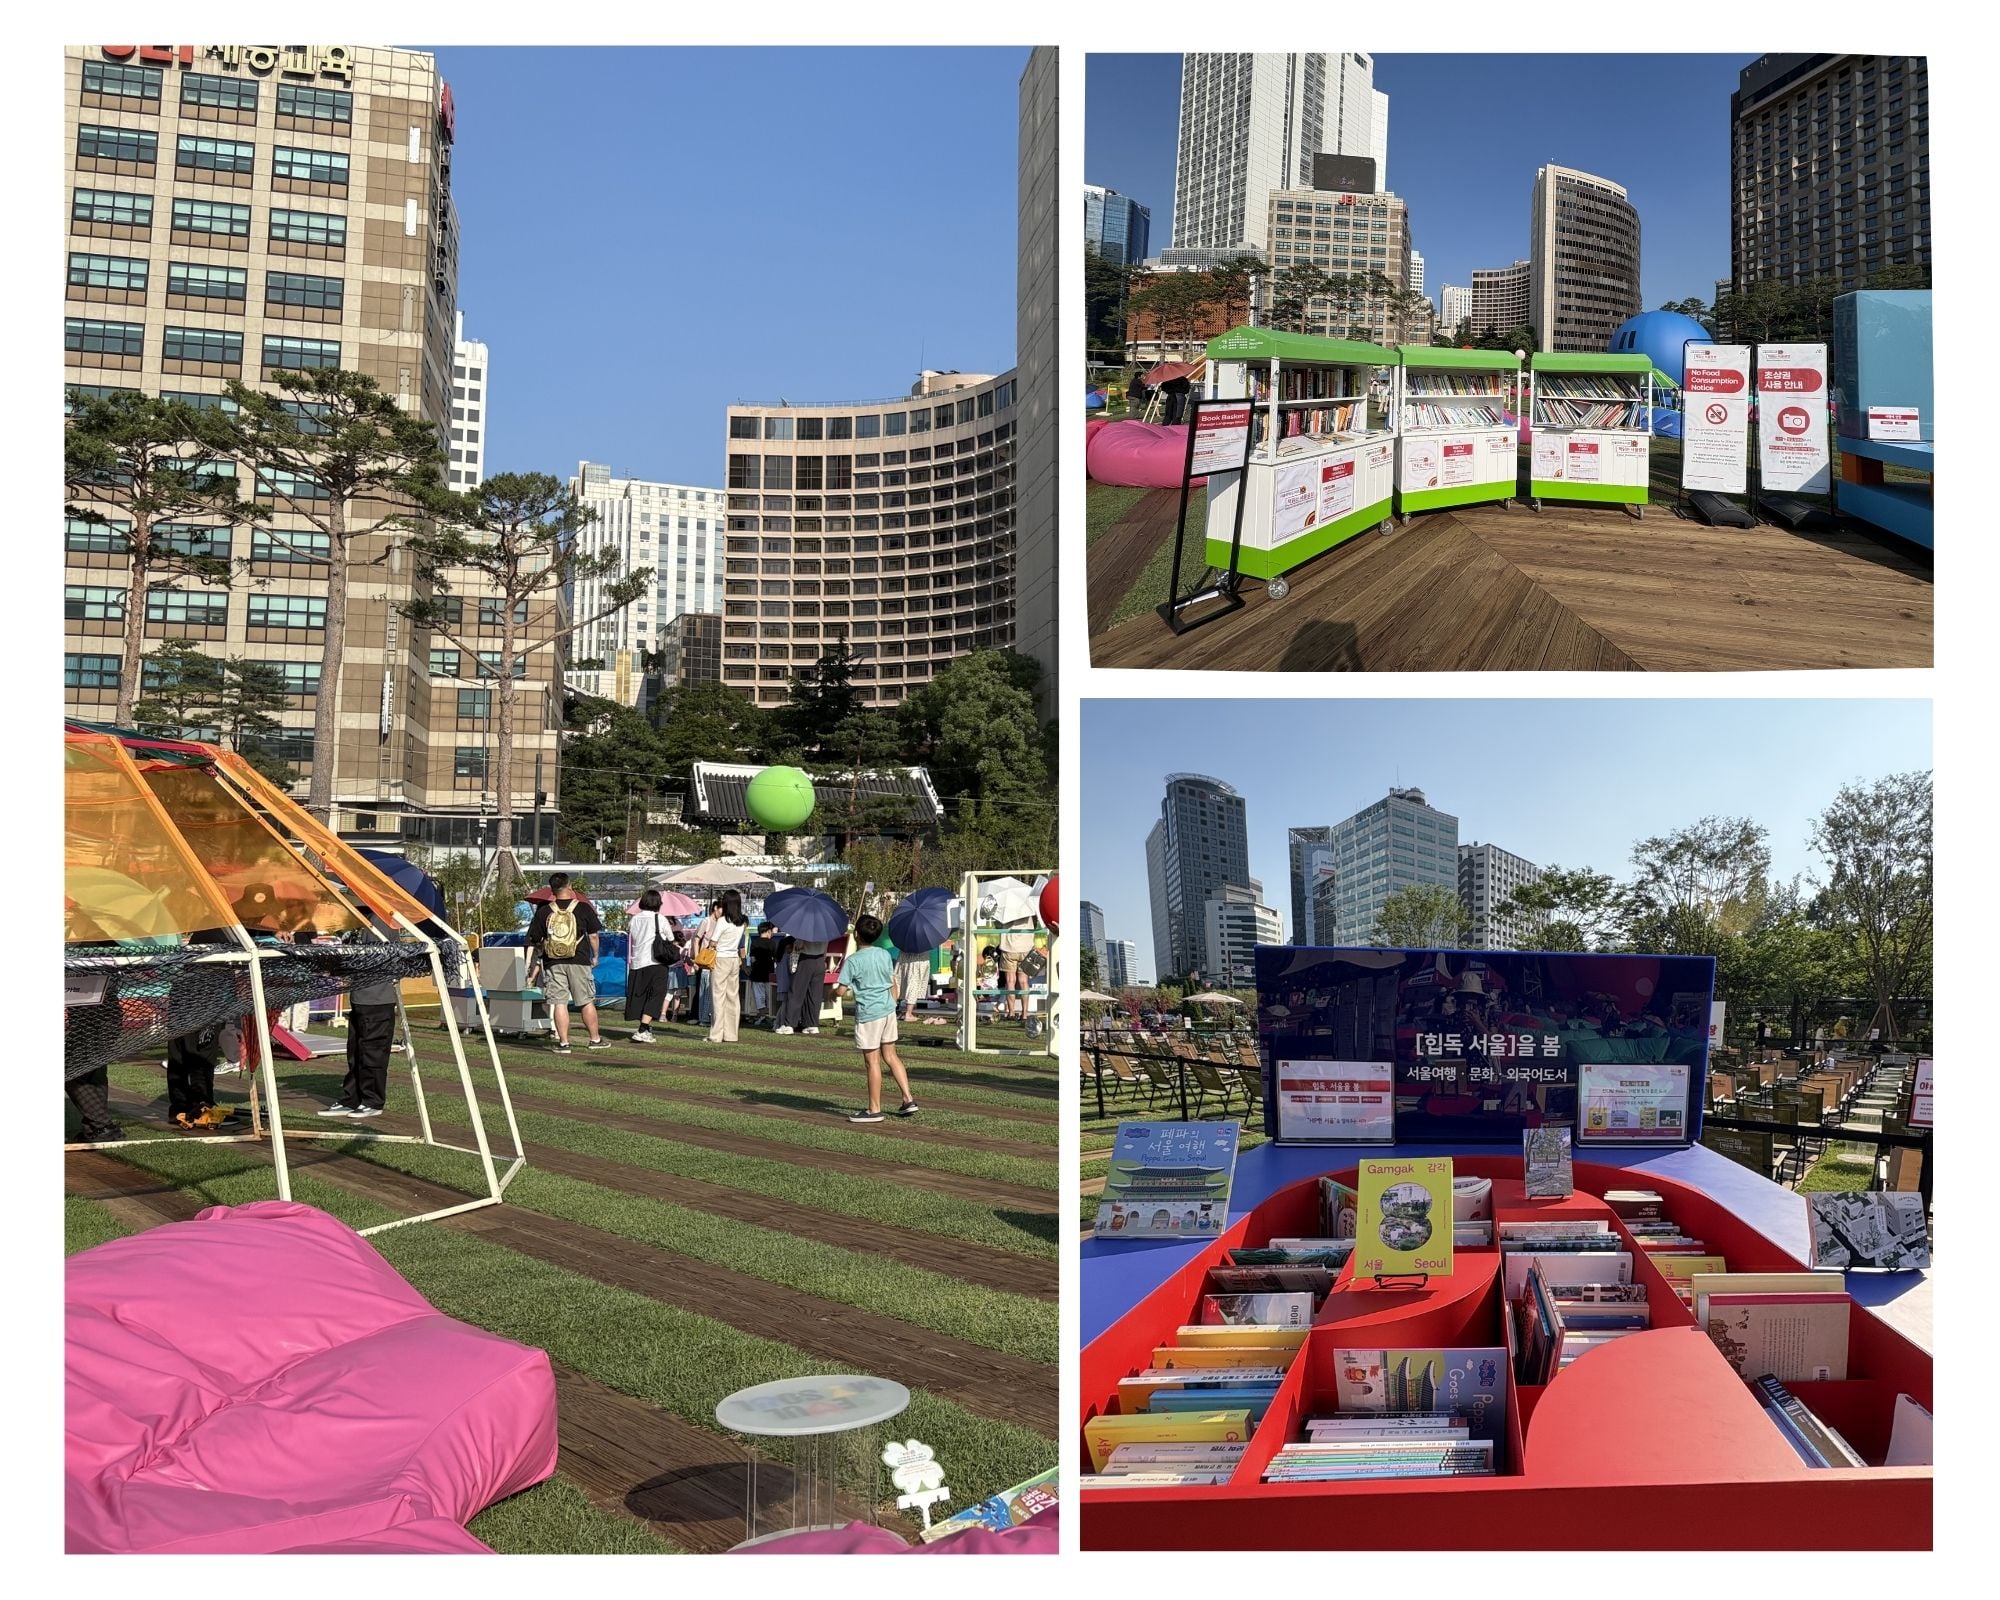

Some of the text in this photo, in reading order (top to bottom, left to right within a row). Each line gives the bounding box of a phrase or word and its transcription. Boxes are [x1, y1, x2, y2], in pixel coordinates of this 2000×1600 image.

[1338, 194, 1356, 205] JEI
[1764, 371, 1791, 379] 초상권
[1691, 377, 1738, 385] Consumption
[1764, 381, 1804, 389] 사용 안내
[1221, 413, 1245, 421] Basket
[1209, 793, 1225, 803] ICBC
[1415, 1032, 1561, 1057] [힙독 서울]을 봄
[1406, 1066, 1568, 1082] 서울여행 문화 외국어도서
[1160, 1128, 1200, 1139] 페파의
[1148, 1139, 1206, 1156] 서울 여행
[1140, 1153, 1161, 1163] Peppa
[1187, 1153, 1207, 1162] Seoul
[1367, 1164, 1415, 1176] Gamgak
[1428, 1162, 1446, 1173] 감각
[1364, 1259, 1384, 1271] 서울
[1414, 1257, 1447, 1269] Seoul
[1448, 1368, 1465, 1400] Goes
